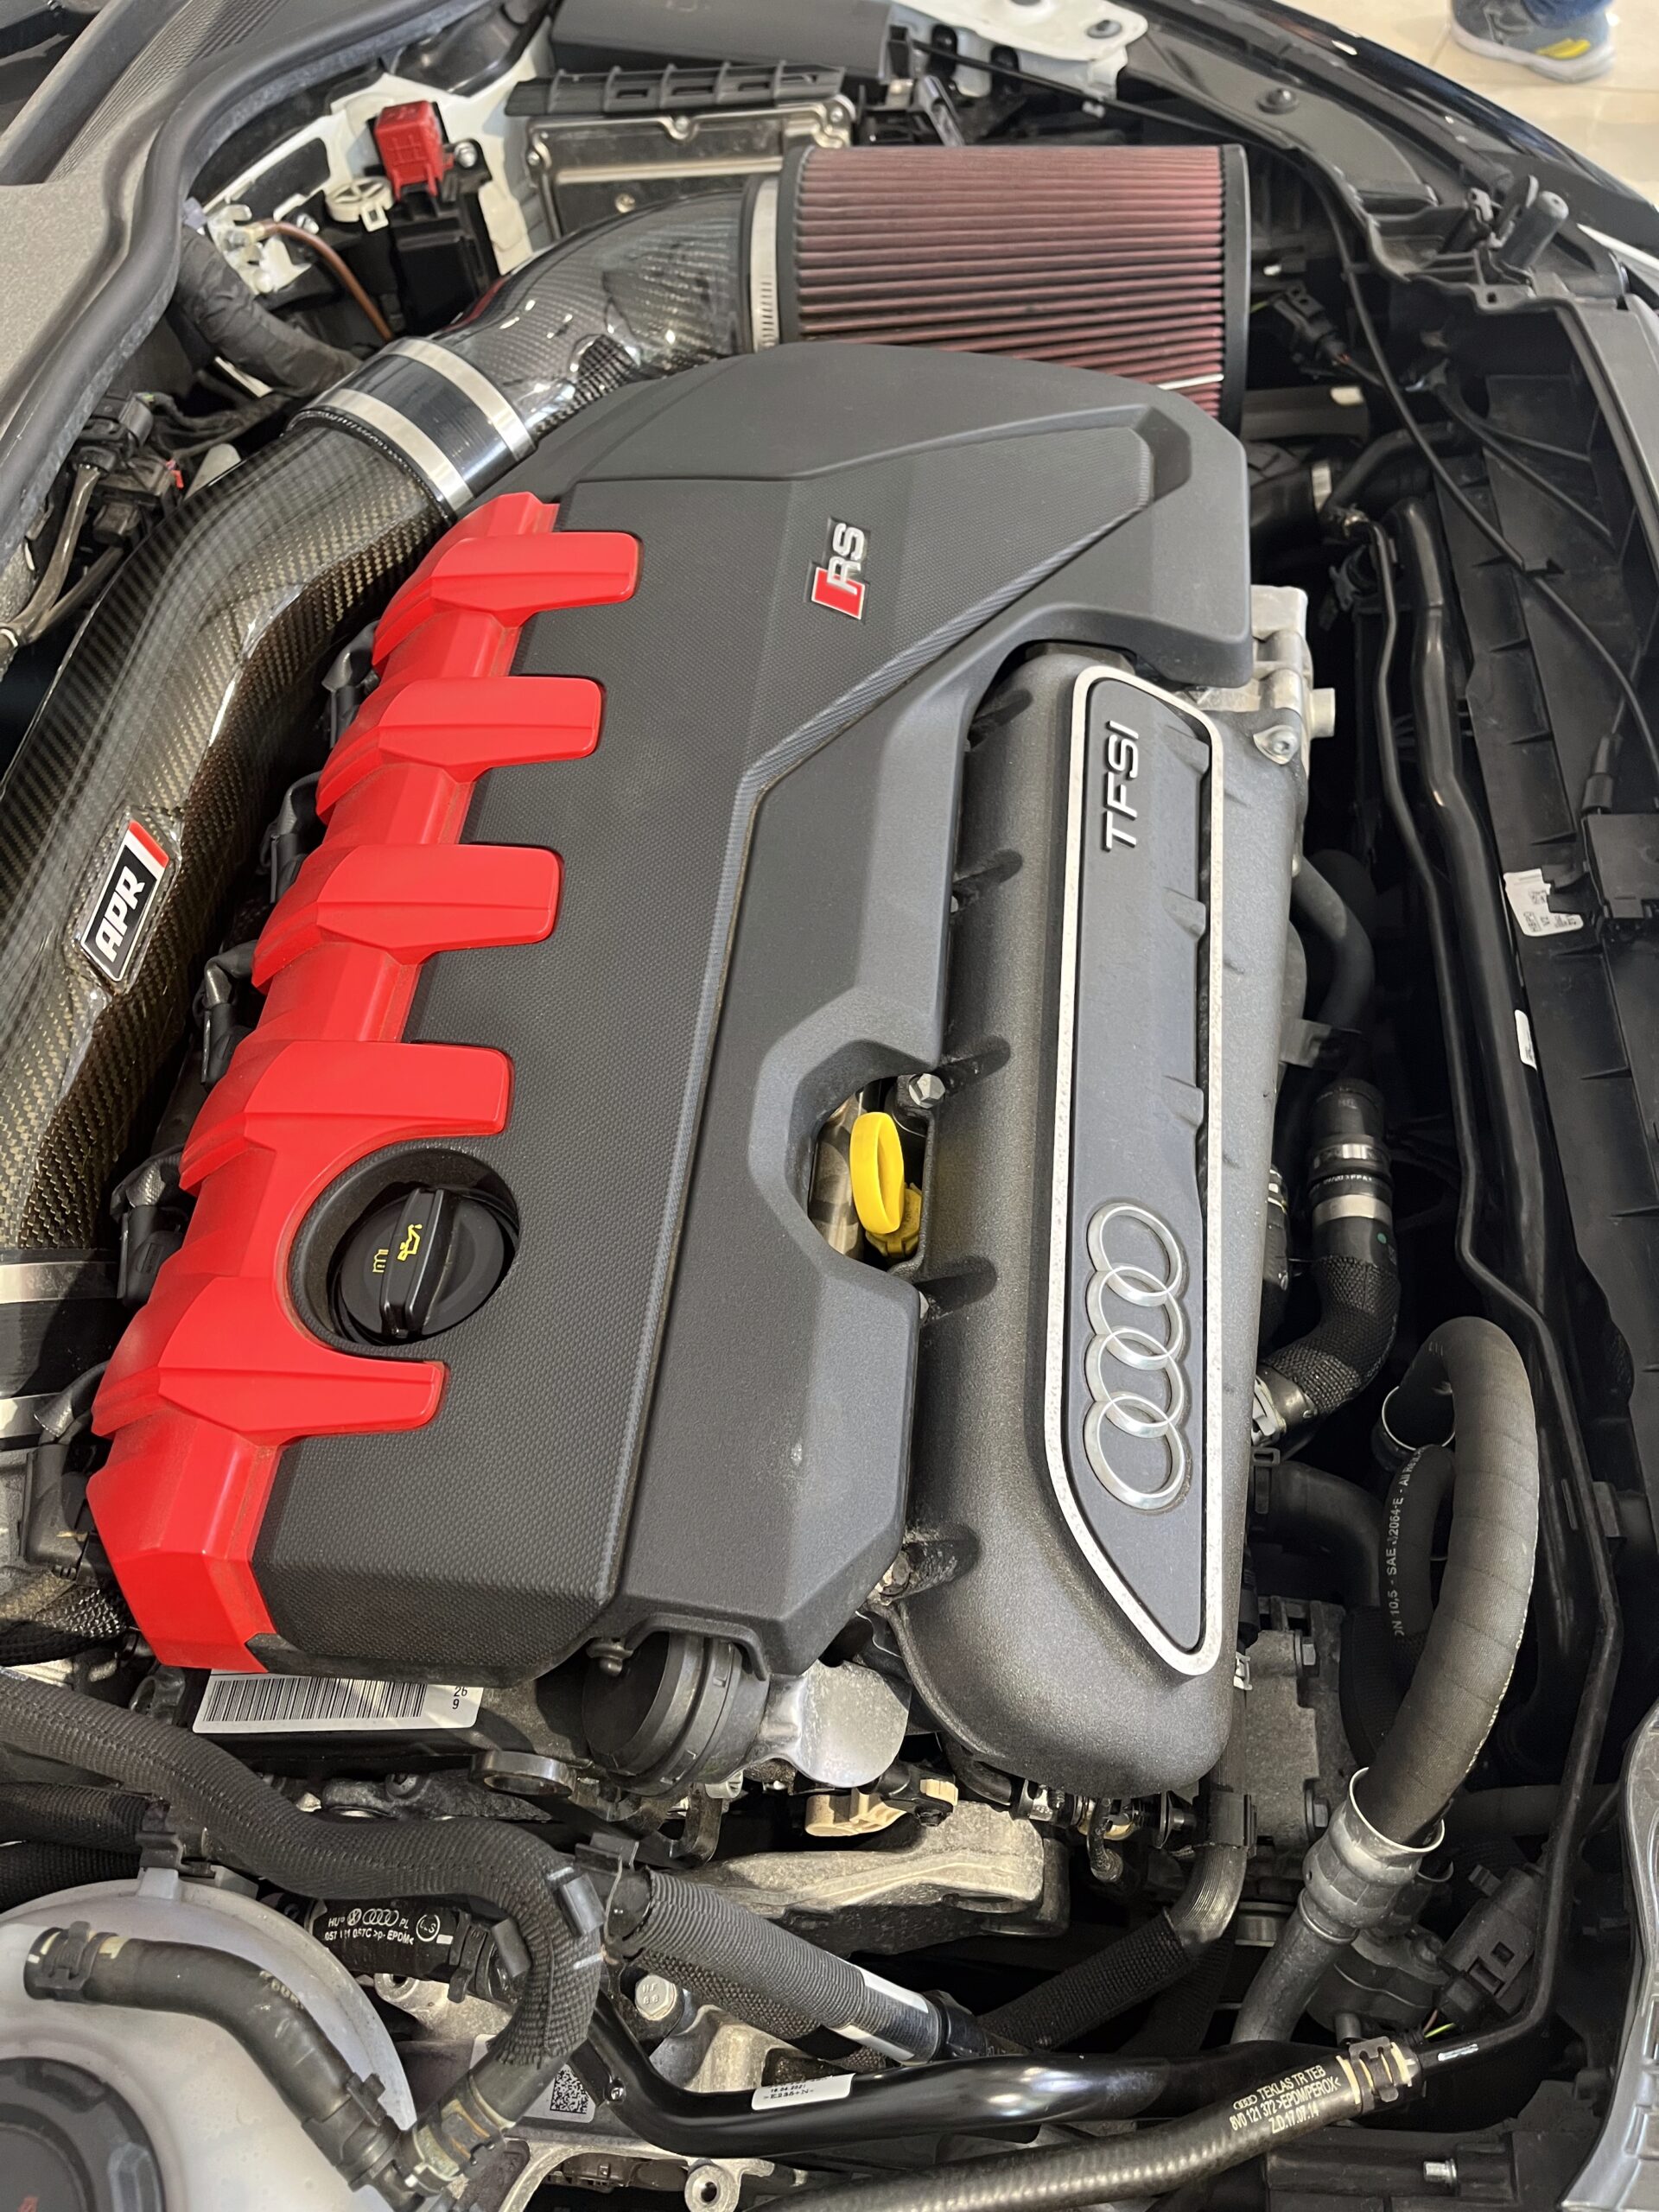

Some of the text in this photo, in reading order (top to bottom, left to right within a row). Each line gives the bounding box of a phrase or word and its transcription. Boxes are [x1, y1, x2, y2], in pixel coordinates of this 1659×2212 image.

[827, 523, 865, 596] RS
[1105, 720, 1139, 849] TFSI
[95, 866, 145, 963] APR
[1386, 1548, 1396, 1575] SAE
[1389, 1590, 1400, 1615] 10,5
[454, 1686, 467, 1697] 26
[452, 1699, 460, 1710] 9
[325, 1931, 337, 1941] 057
[399, 1918, 409, 1929] PL
[1257, 2064, 1326, 2101] TEKLAS TR TEB
[1246, 2106, 1262, 2123] 121
